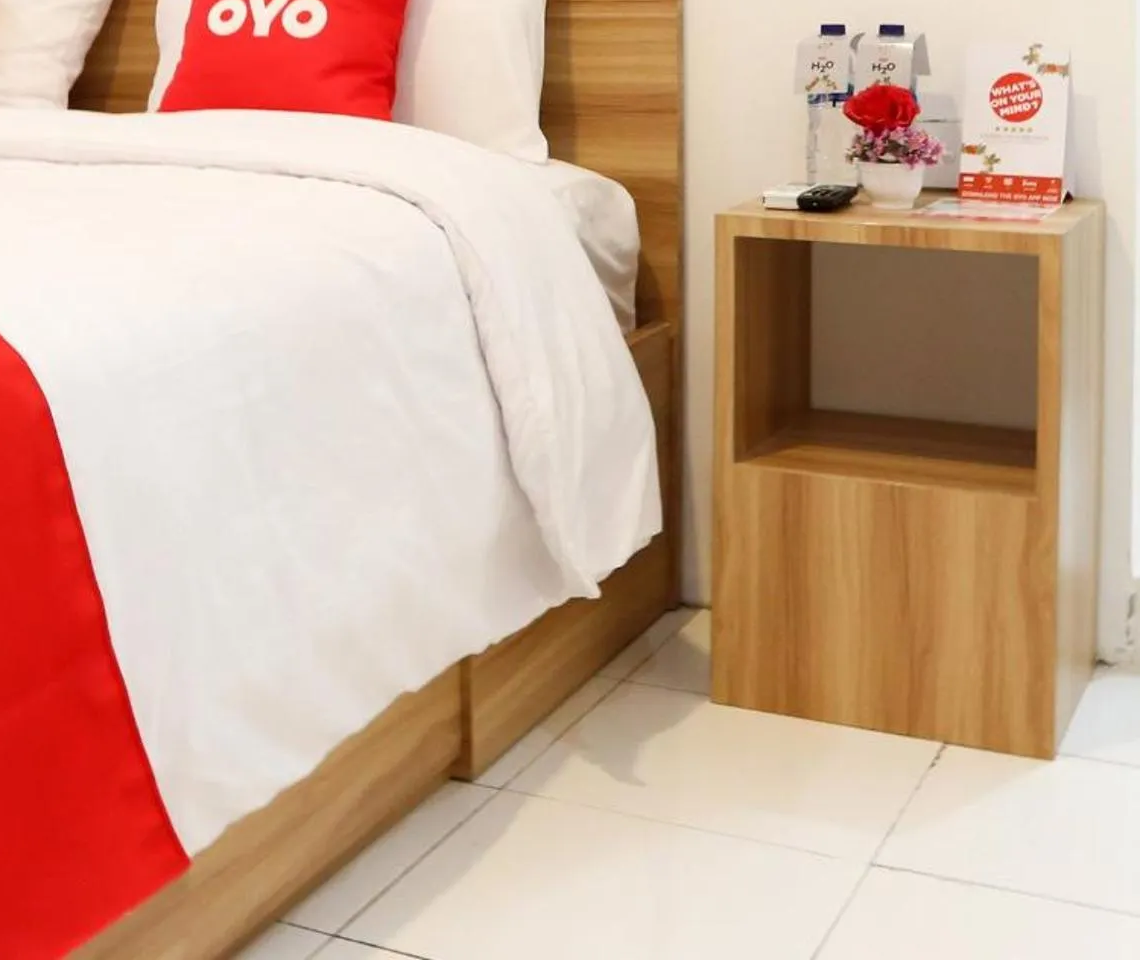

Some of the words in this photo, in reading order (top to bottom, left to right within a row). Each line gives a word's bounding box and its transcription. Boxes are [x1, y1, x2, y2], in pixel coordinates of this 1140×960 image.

[991, 79, 1037, 97] WHAT'S
[990, 97, 1008, 108] ON
[1009, 88, 1042, 103] YOUR
[999, 101, 1039, 117] MIND?
